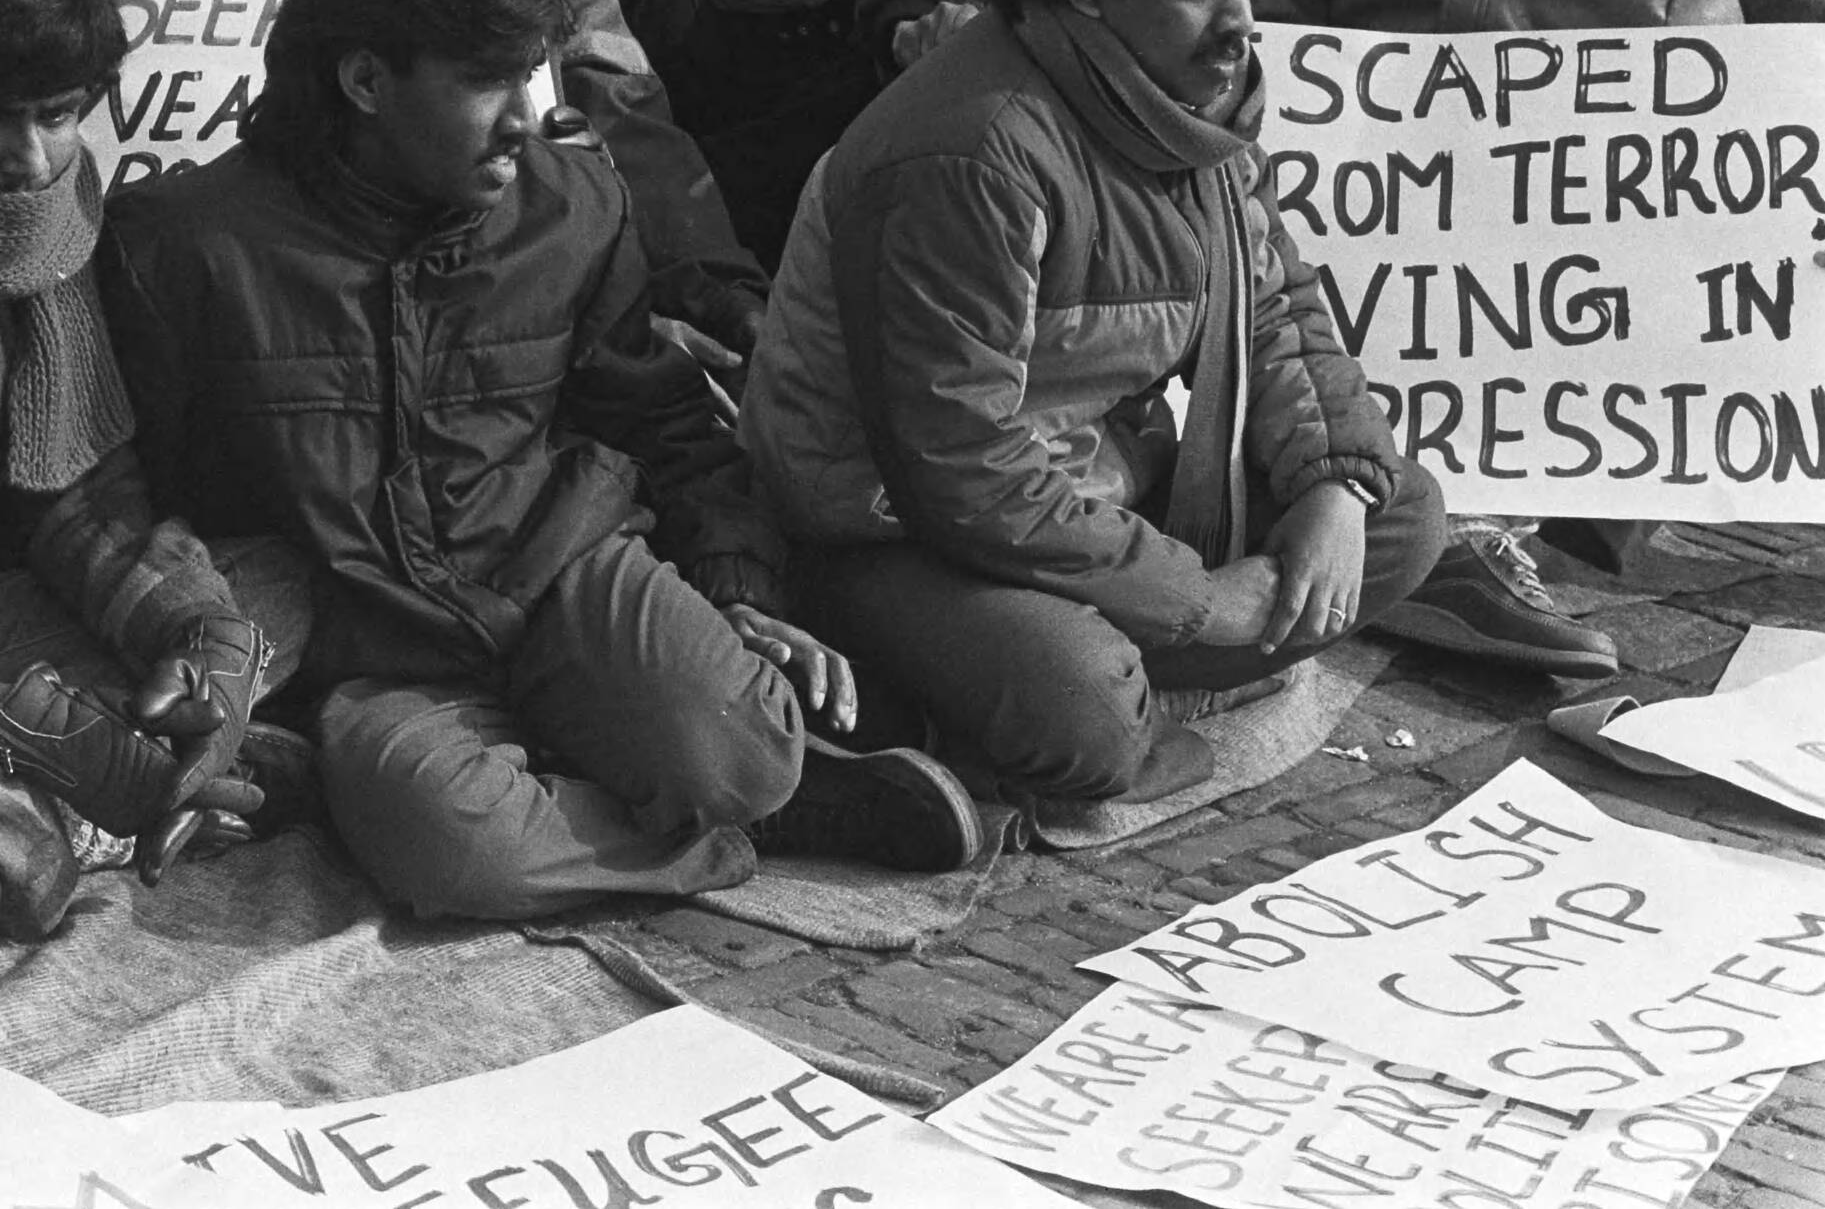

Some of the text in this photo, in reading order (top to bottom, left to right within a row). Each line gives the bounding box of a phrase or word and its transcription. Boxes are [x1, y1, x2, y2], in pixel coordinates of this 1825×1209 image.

[1249, 32, 1729, 127] SCAPED
[1696, 257, 1796, 342] IN
[1131, 800, 1594, 993] ABOLISH
[1378, 882, 1662, 1019] CAMP
